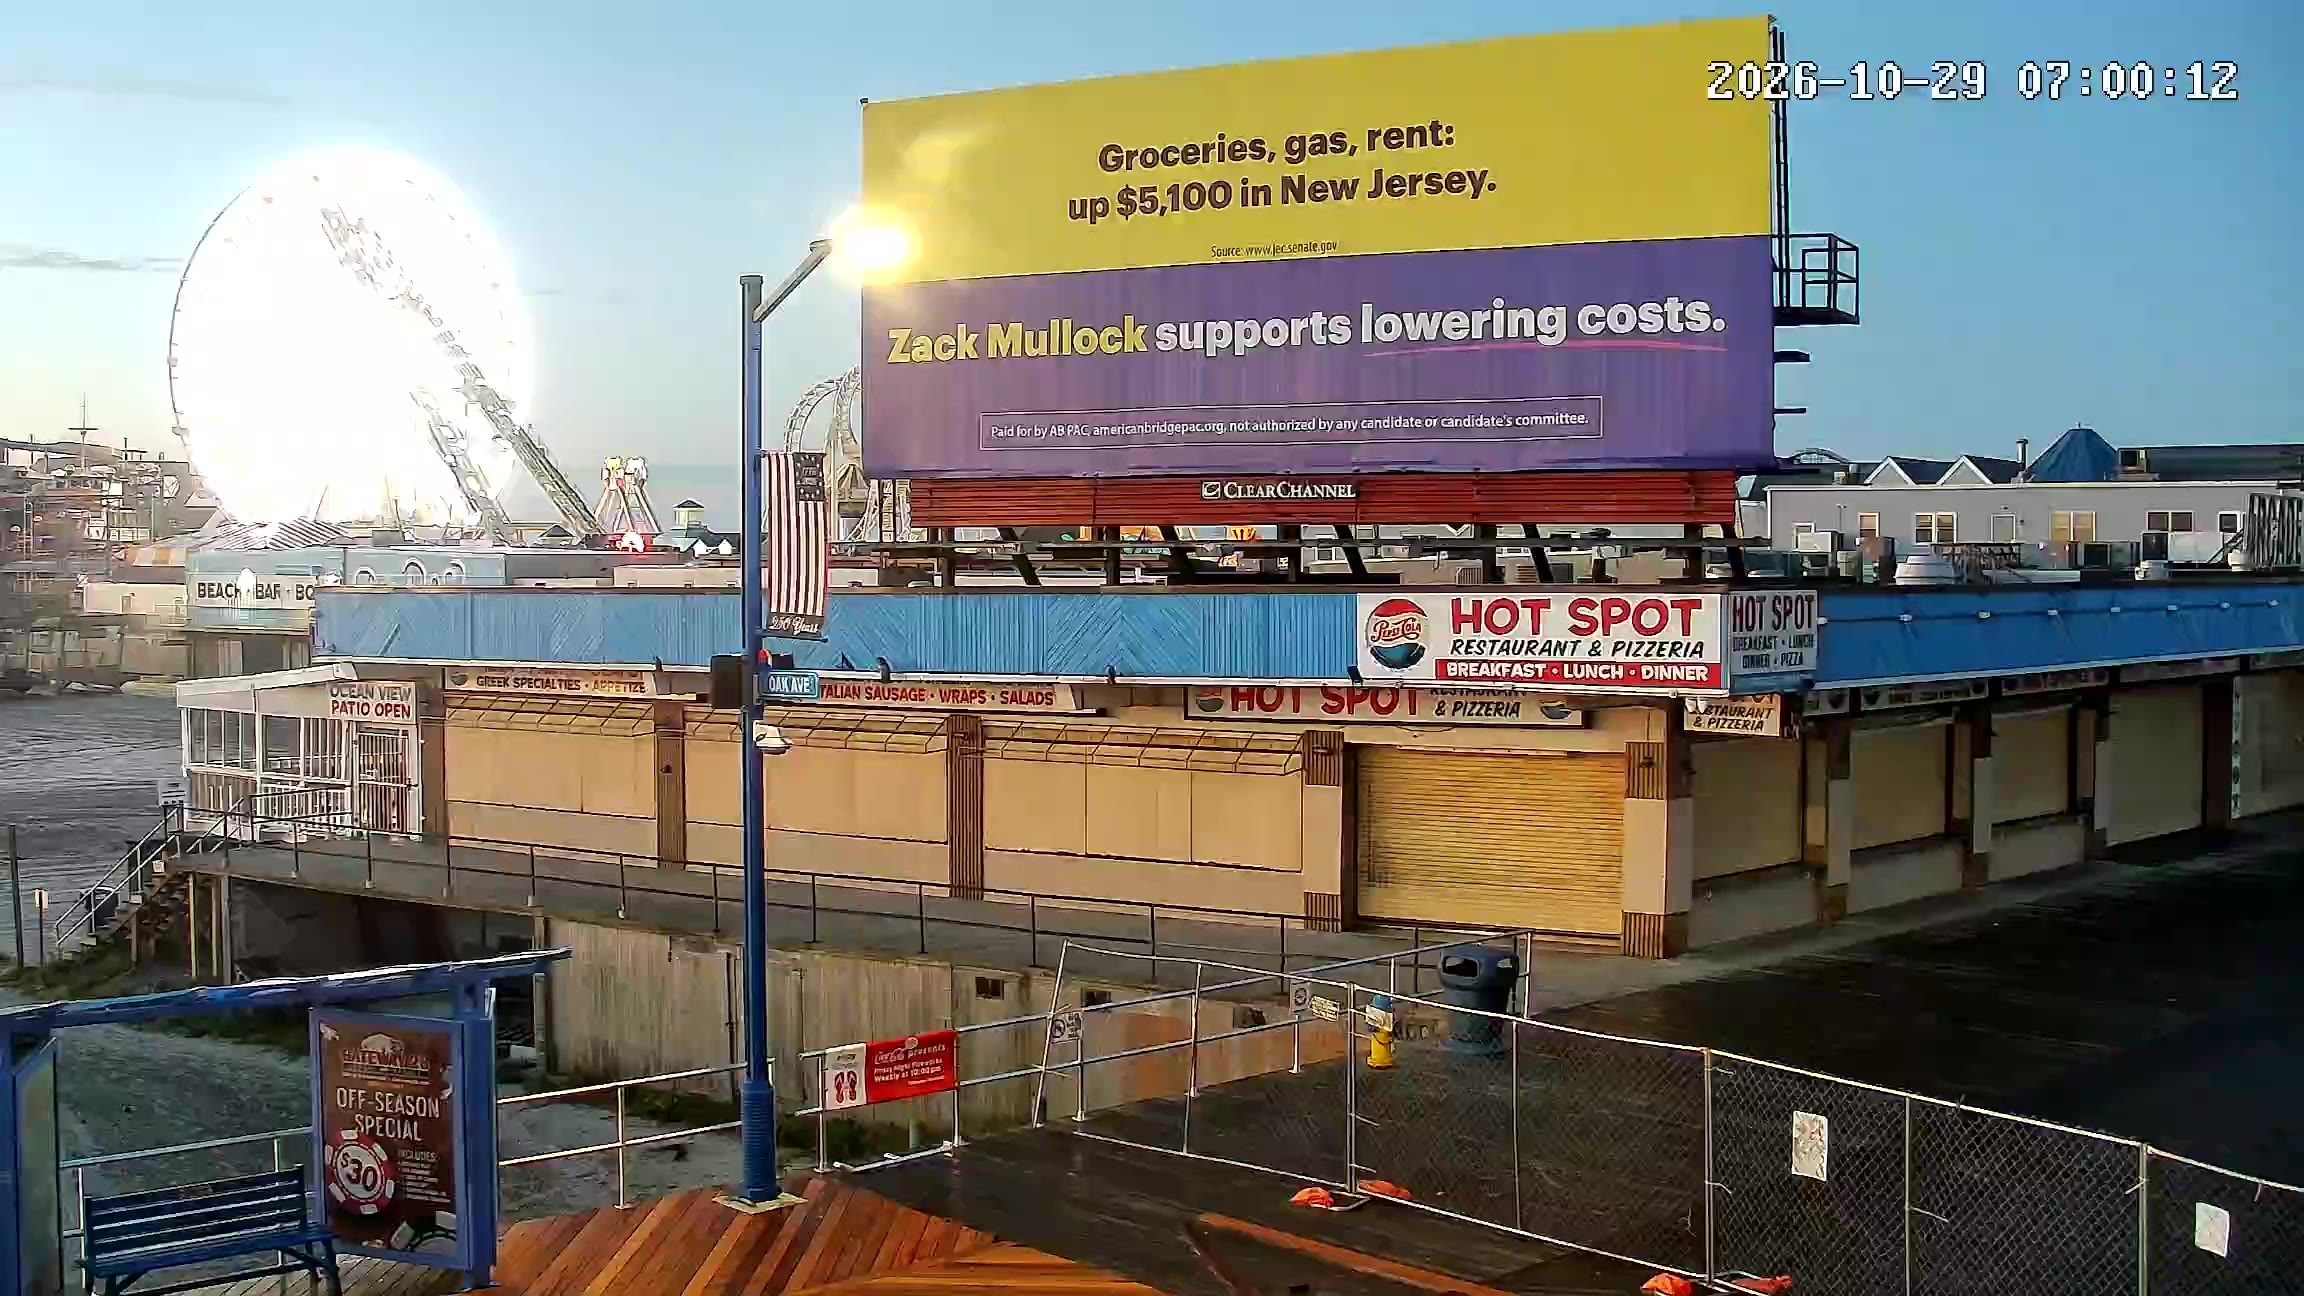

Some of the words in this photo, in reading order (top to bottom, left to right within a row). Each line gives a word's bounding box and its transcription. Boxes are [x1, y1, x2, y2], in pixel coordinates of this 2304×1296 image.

[1099, 133, 1276, 172] Groceries,
[1285, 131, 1358, 162] gas,
[1367, 118, 1455, 151] rent:
[1069, 194, 1109, 223] up
[1117, 180, 1232, 219] $5,100
[1241, 177, 1272, 208] in
[1281, 168, 1357, 204] New
[1367, 166, 1497, 203] Jersey.
[1211, 245, 1244, 257] Source:
[887, 326, 979, 364] Zack
[987, 315, 1148, 359] Mullock
[1154, 305, 1352, 358] supports
[1360, 297, 1568, 347] lowering
[1576, 295, 1726, 335] costs.
[991, 426, 1014, 438] Paid
[1017, 425, 1031, 437] for
[1034, 425, 1047, 438] by
[1050, 426, 1065, 437] AB
[1229, 420, 1249, 431] not
[1251, 418, 1315, 432] authorized
[1317, 418, 1334, 431] by
[1335, 419, 1358, 431] any
[1361, 416, 1422, 429] candidate
[1425, 417, 1439, 428] or
[1441, 414, 1513, 427] candidate's
[1515, 412, 1590, 426] committee.
[1450, 597, 1551, 636] HOT
[1567, 598, 1703, 637] SPOT
[1732, 596, 1767, 633] HOT
[1772, 594, 1815, 631] SPOT
[1451, 639, 1585, 657] RESTAURANT
[1588, 641, 1601, 657] &
[1611, 640, 1704, 659] PIZZERIA
[476, 675, 510, 688] GREEK
[513, 677, 581, 691] SPECIALTIES
[1447, 662, 1547, 679] BREAKFAST
[1563, 663, 1624, 680] LUNCH
[1640, 664, 1708, 681] DINNER
[330, 684, 374, 699] OCEAN
[377, 686, 412, 700] VIEW
[769, 675, 790, 692] OAK
[820, 683, 861, 700] TALIAN
[865, 685, 926, 702] SAUSAGE
[939, 688, 986, 704] WRAPS
[1000, 689, 1054, 706] SALADS
[331, 702, 371, 716] PATIO
[374, 703, 412, 718] OPEN
[1434, 700, 1446, 717] &
[1451, 700, 1521, 717] PIZZERIA
[1693, 716, 1702, 727] &
[1707, 717, 1764, 731] PIZZERIA
[336, 1087, 440, 1118] OFF-SEASON
[354, 1113, 424, 1142] SPECIAL
[340, 1151, 378, 1191] $30
